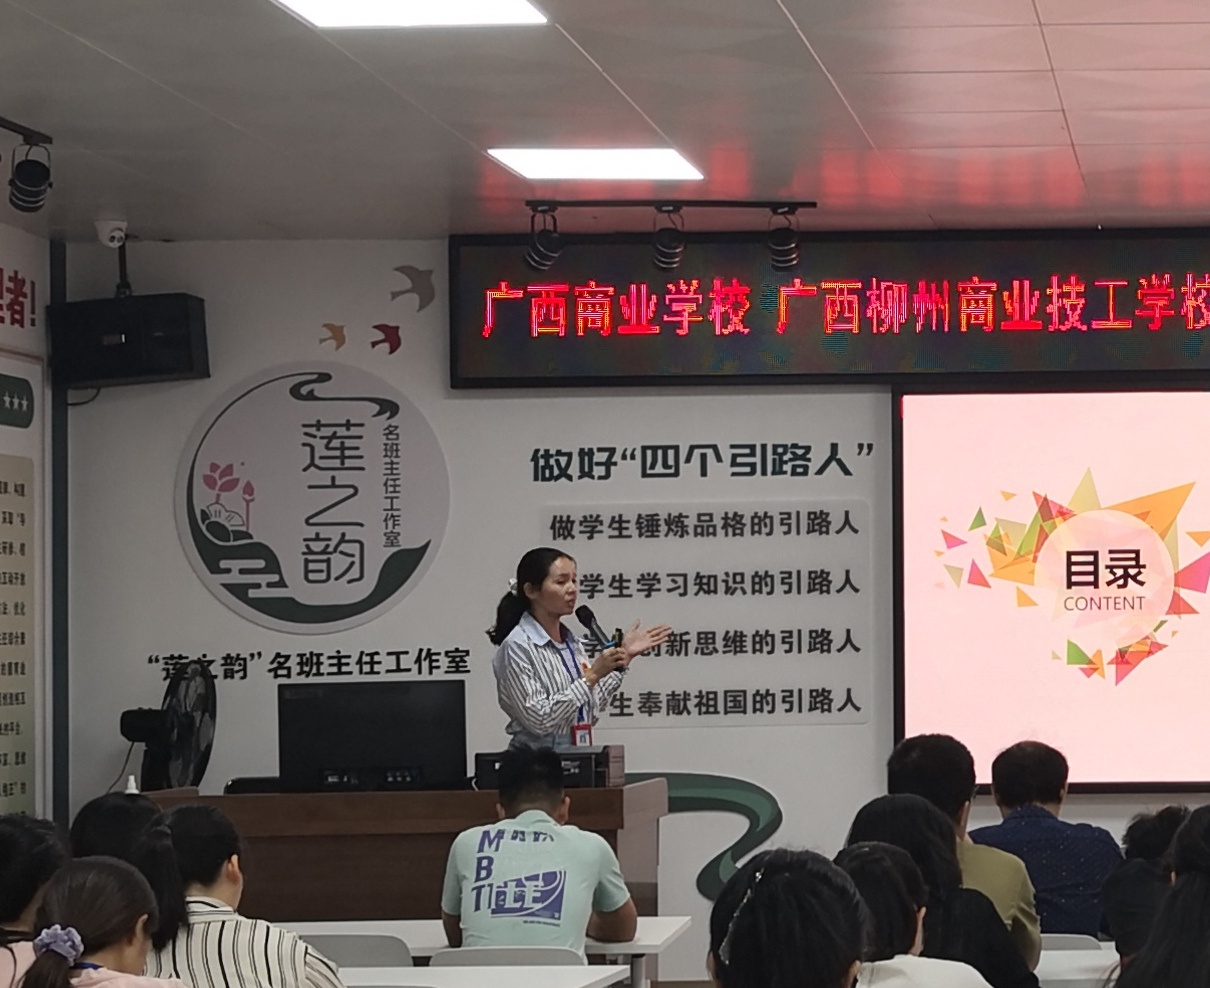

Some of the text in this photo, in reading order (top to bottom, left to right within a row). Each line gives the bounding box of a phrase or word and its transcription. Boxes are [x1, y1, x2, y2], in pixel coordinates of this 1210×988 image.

[0, 268, 36, 328] 者！
[482, 278, 752, 338] 广西商业学校
[530, 442, 874, 482] 做好“四个引路人”
[301, 419, 366, 584] 莲之韵
[383, 424, 401, 548] 名班主任工作室
[550, 509, 860, 541] 做学生锤炼品格的引路人
[579, 568, 861, 600] 学生学习知识的引路人
[1066, 549, 1147, 590] 目录
[1064, 596, 1146, 611] CONTENT
[609, 687, 862, 718] 生奉献祖国的引路人
